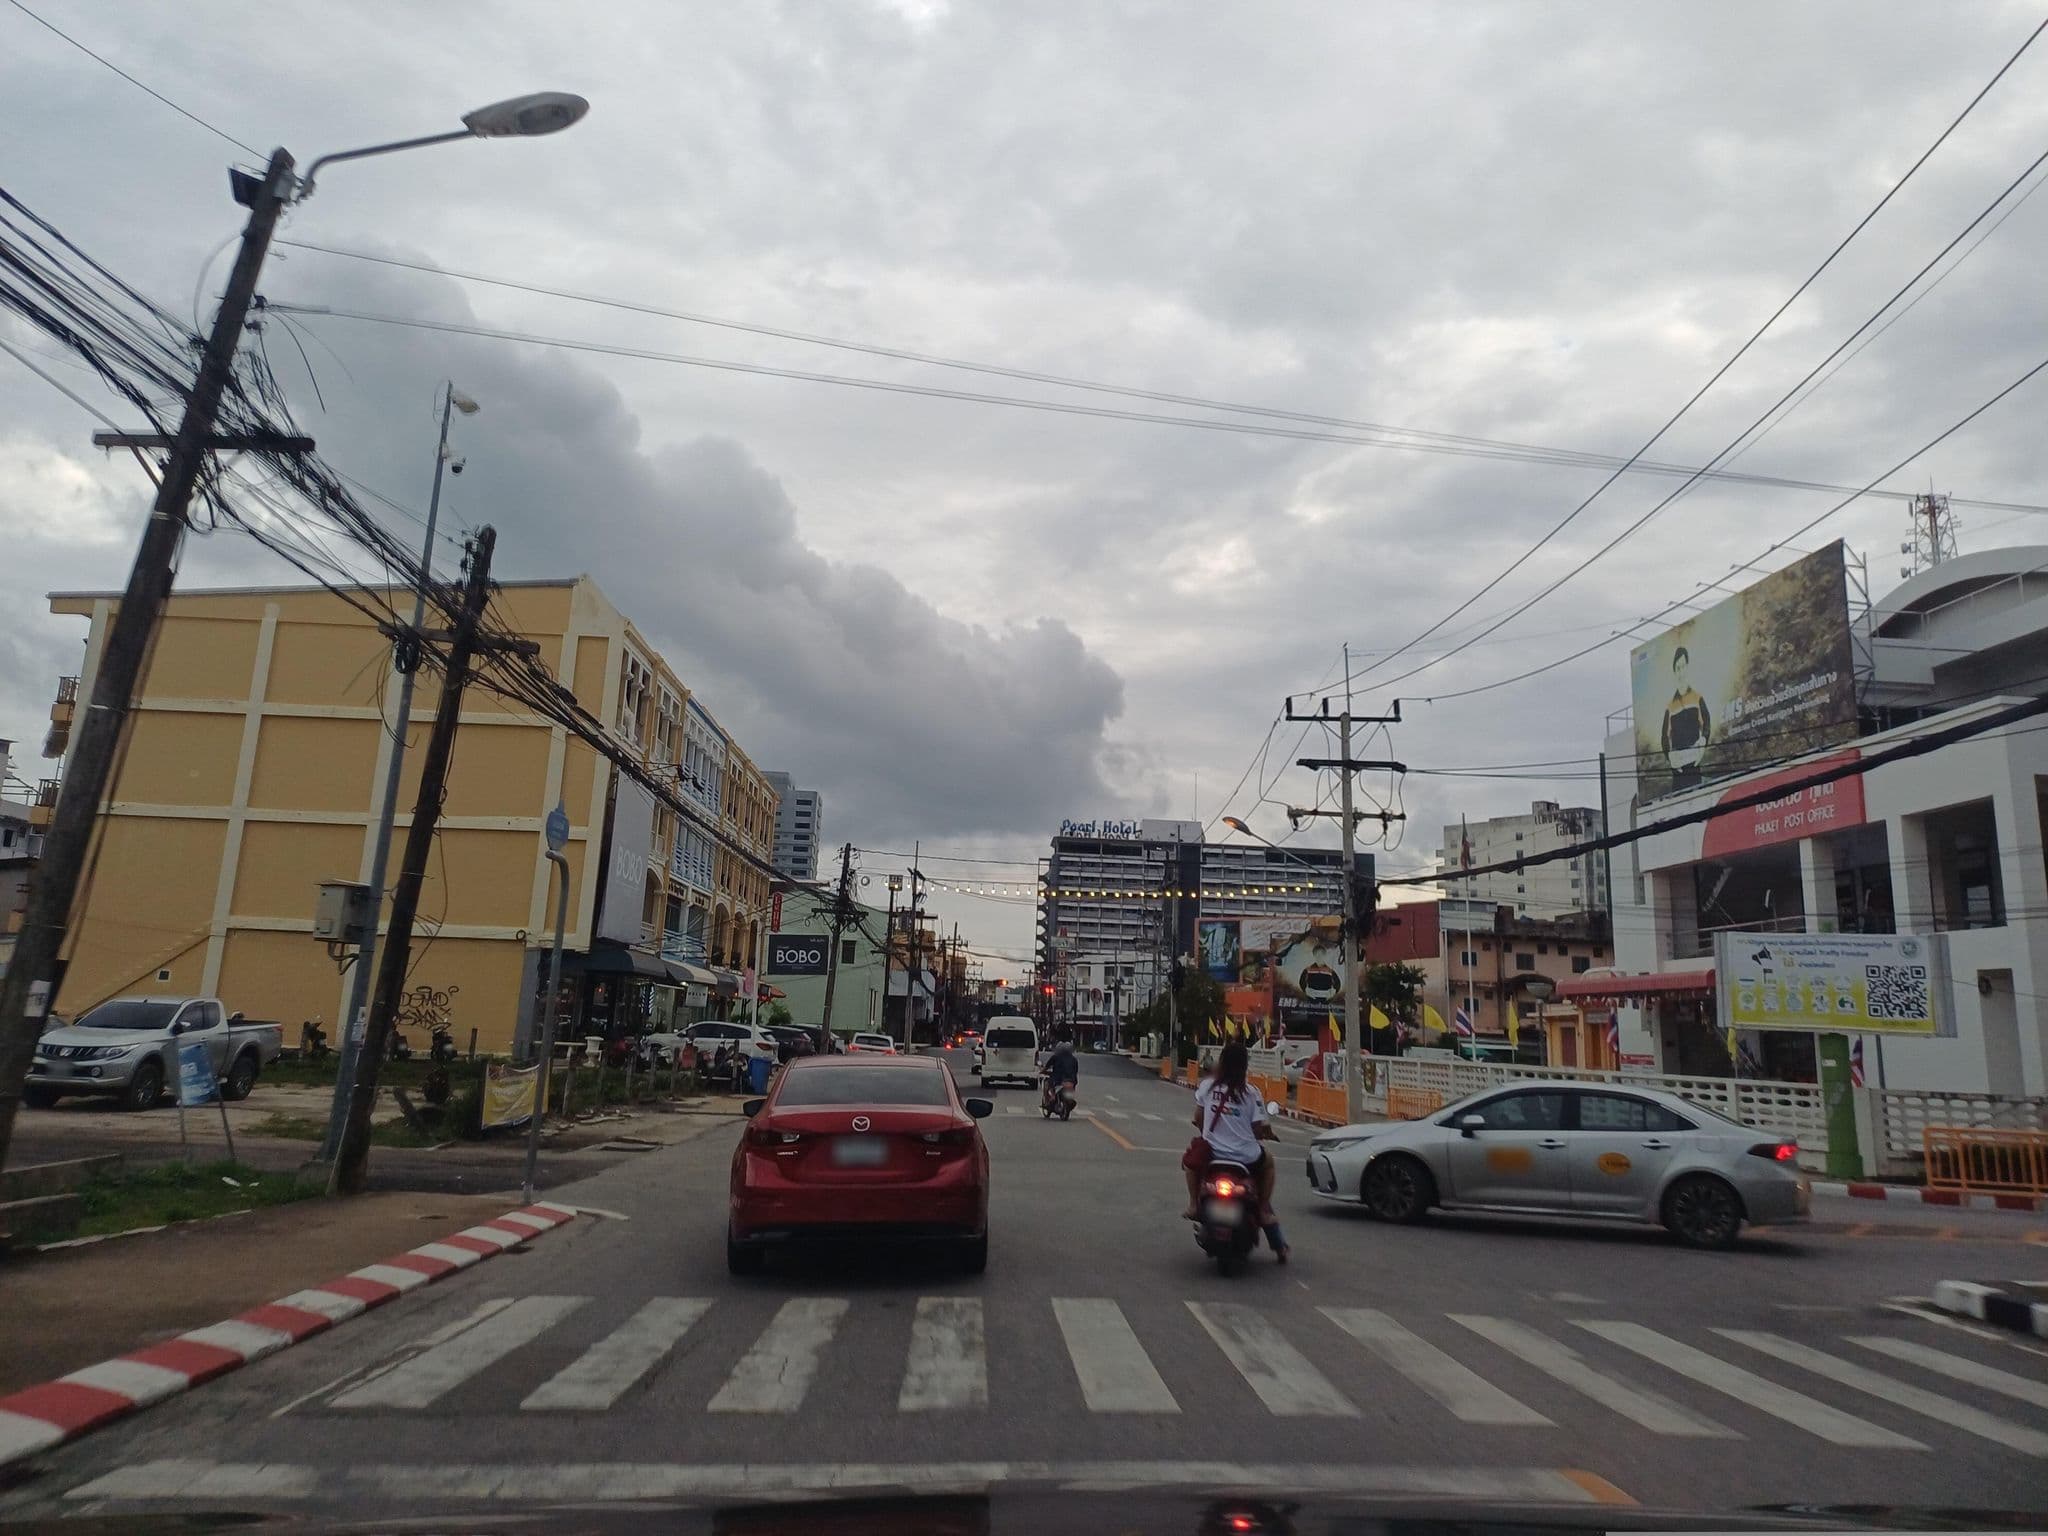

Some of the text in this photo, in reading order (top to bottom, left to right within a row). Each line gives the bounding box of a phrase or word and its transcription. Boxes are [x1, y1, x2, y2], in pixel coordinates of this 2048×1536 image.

[1061, 819, 1137, 834] Pearl Hotel
[1755, 805, 1834, 835] PHUKET POST OFFICE
[616, 845, 642, 884] BOBO
[776, 949, 821, 964] BOBO
